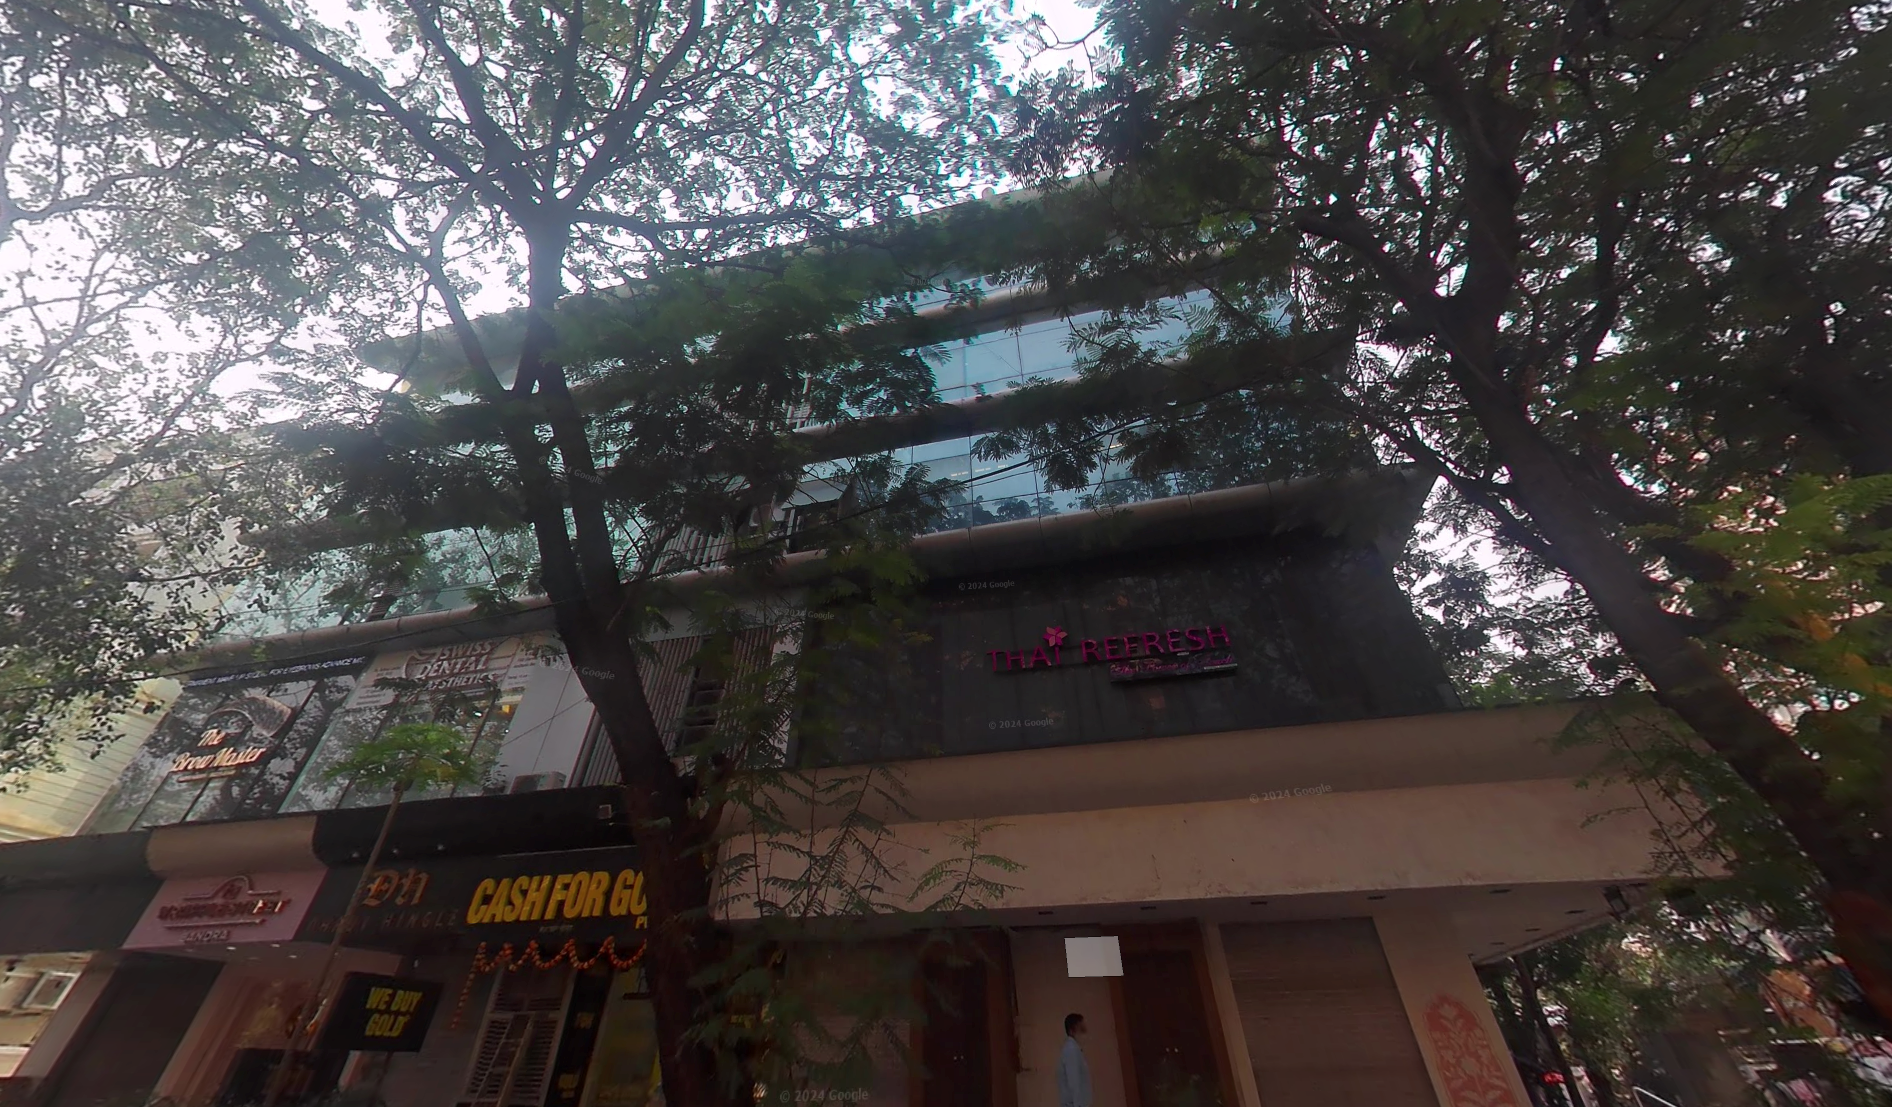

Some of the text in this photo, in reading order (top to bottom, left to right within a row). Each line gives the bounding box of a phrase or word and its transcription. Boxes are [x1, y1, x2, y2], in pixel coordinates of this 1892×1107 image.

[439, 640, 495, 660] SWISS
[987, 624, 1232, 673] THAI REFRESH
[416, 655, 490, 679] DENTAL
[197, 728, 227, 748] The
[169, 745, 267, 773] Brow Master
[465, 874, 553, 925] CASH
[543, 870, 612, 921] FOR
[365, 986, 424, 1012] WE BUY
[364, 1012, 411, 1038] GOLD
